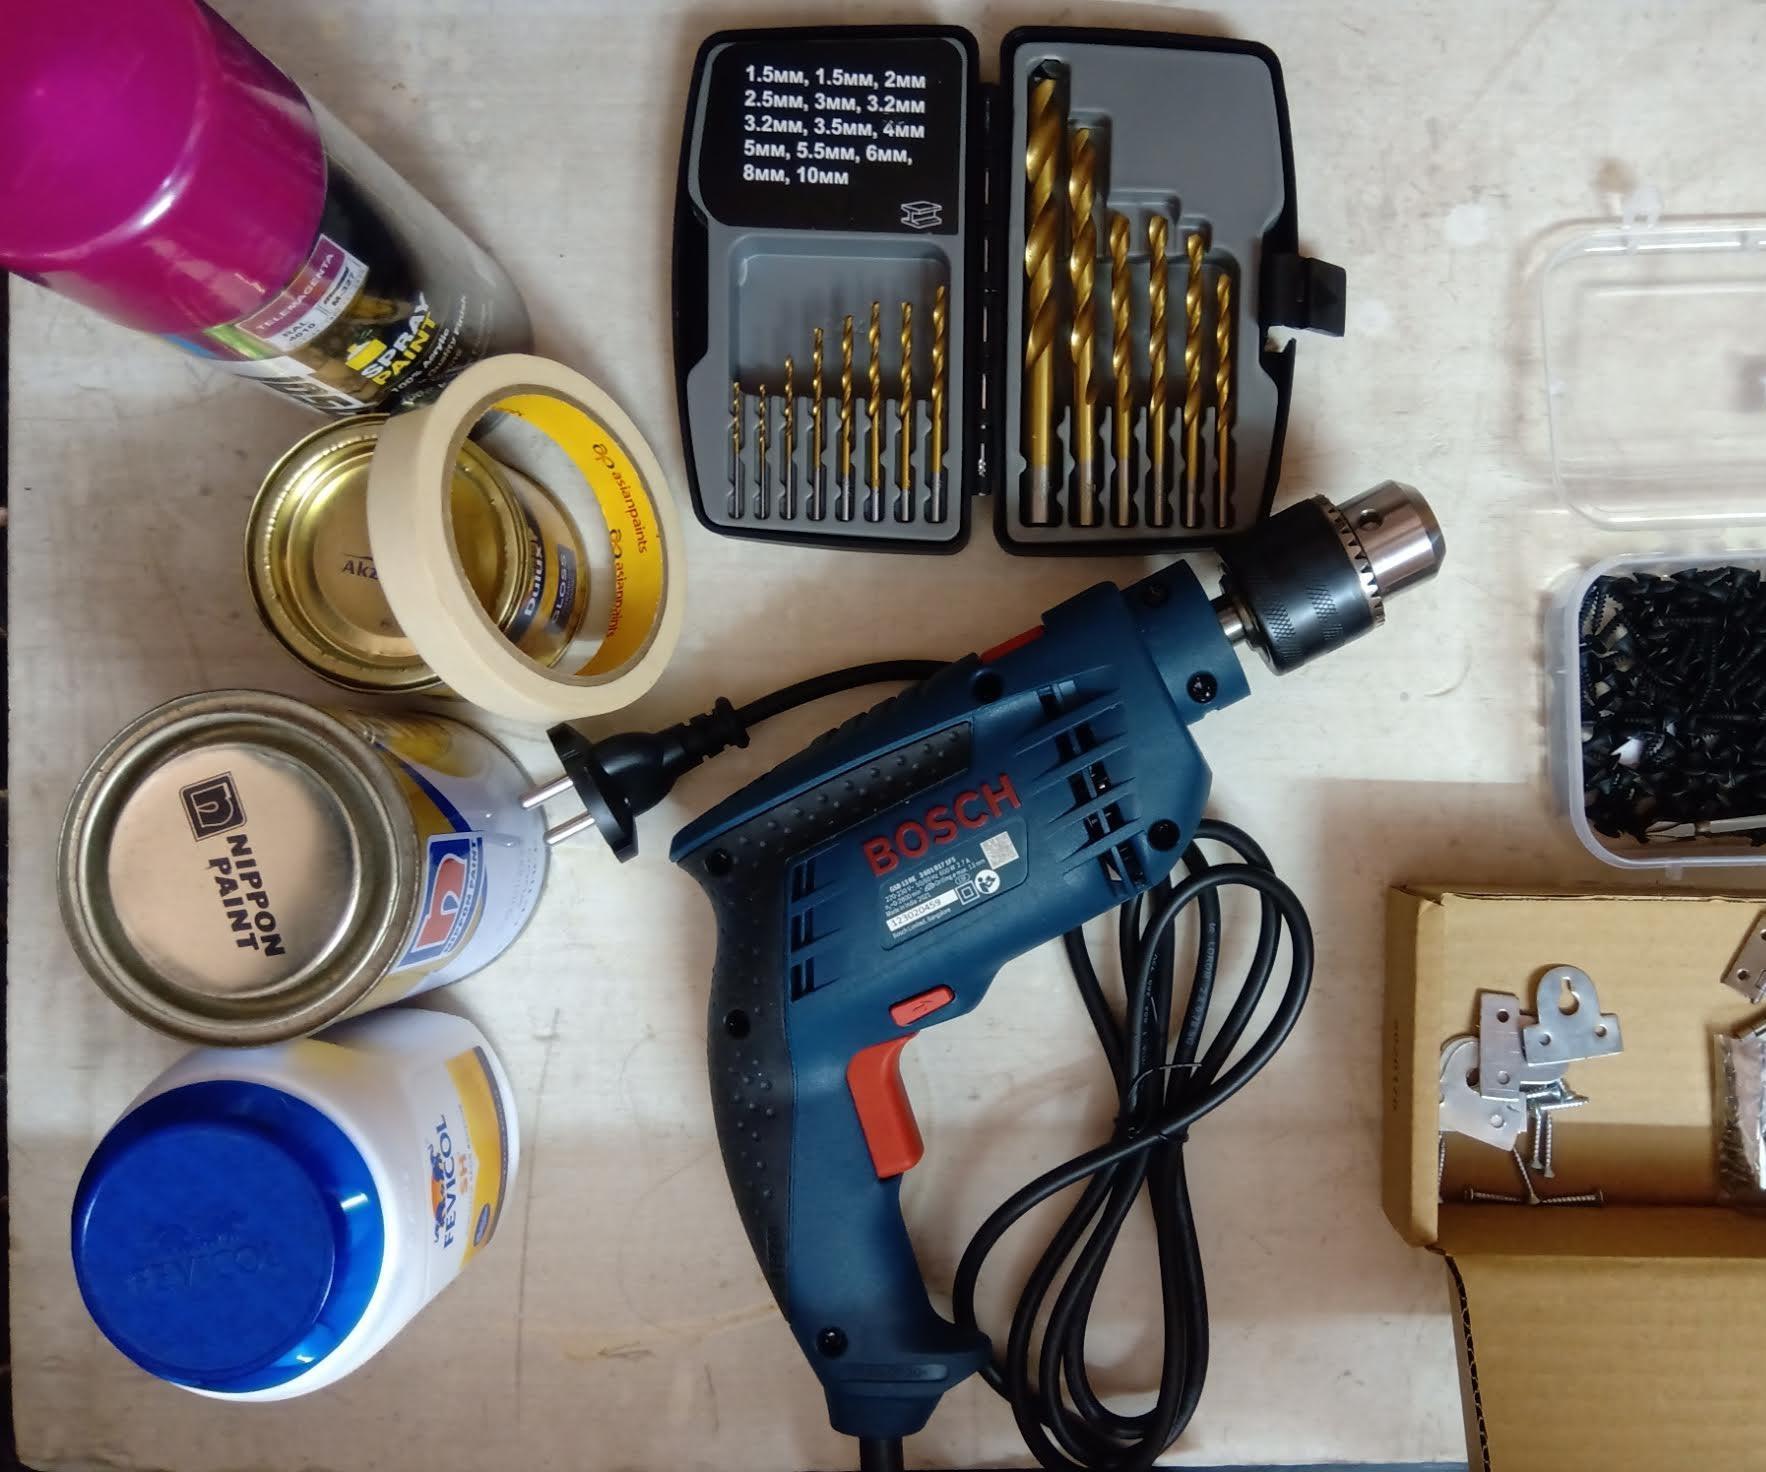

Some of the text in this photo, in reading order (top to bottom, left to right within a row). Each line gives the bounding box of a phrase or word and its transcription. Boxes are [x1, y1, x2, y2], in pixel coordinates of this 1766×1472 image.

[867, 95, 926, 113] 3.2MM
[884, 71, 926, 89] 2MM
[797, 167, 849, 185] 10MM
[361, 291, 429, 379] SPRAY
[372, 311, 436, 385] PAINT
[612, 472, 648, 554] asianpaints
[863, 773, 1022, 877] BOSCH
[208, 857, 259, 950] PAINT
[227, 834, 285, 956] NIPPON
[890, 897, 942, 927] 123020459
[436, 1114, 456, 1248] FEVICOL
